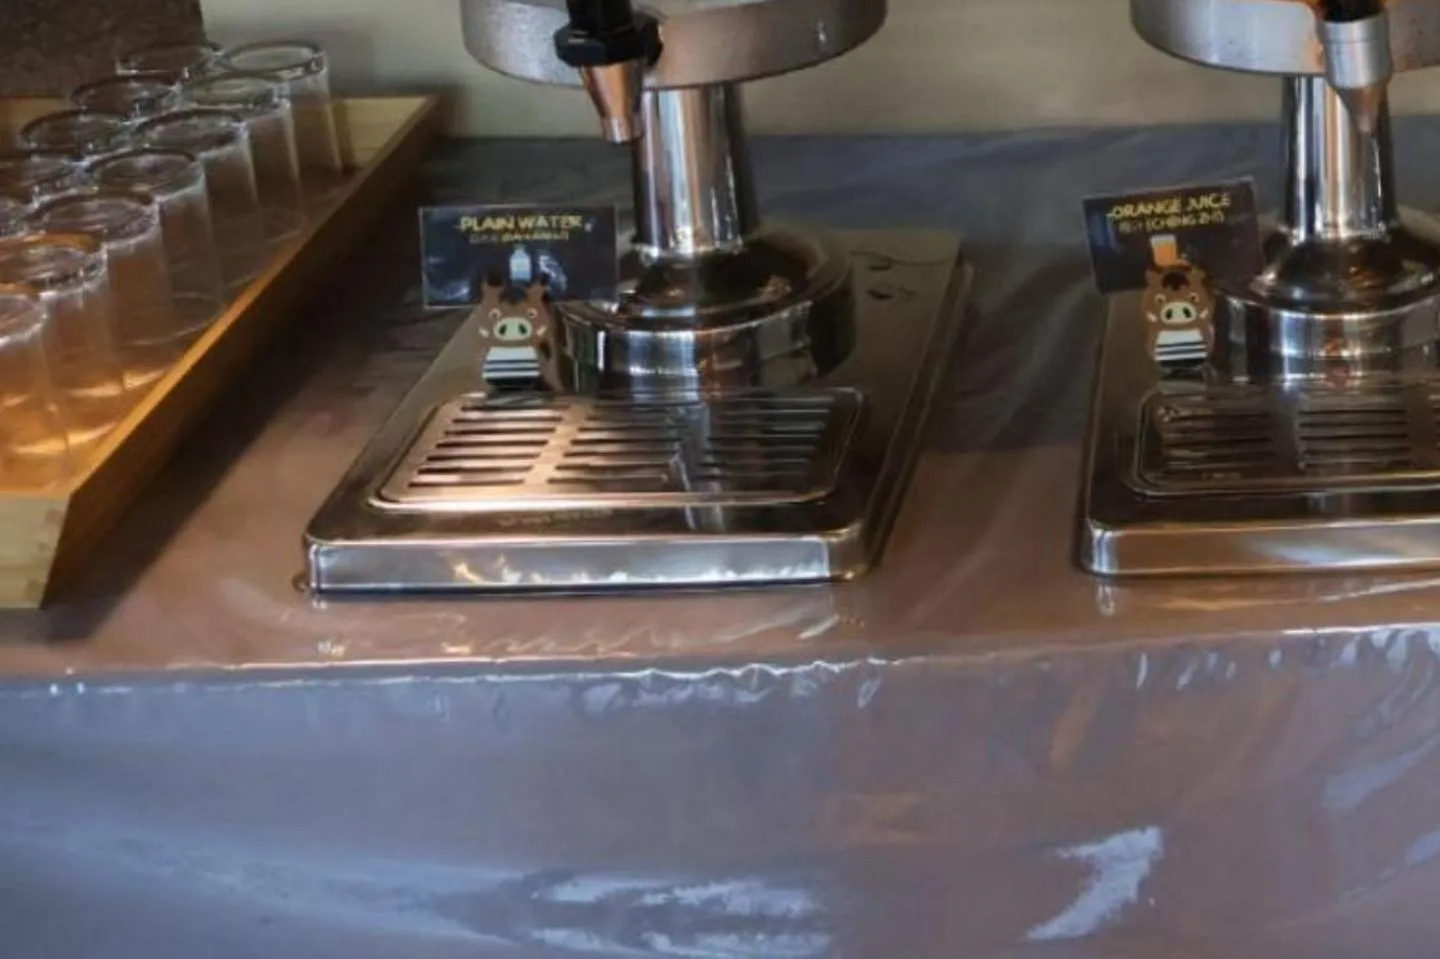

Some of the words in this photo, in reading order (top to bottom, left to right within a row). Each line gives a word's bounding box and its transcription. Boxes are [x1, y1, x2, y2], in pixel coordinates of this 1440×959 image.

[1112, 198, 1182, 217] ORANGE
[1188, 193, 1231, 210] JUICE
[460, 215, 515, 231] PLAIN
[519, 214, 583, 229] WATER
